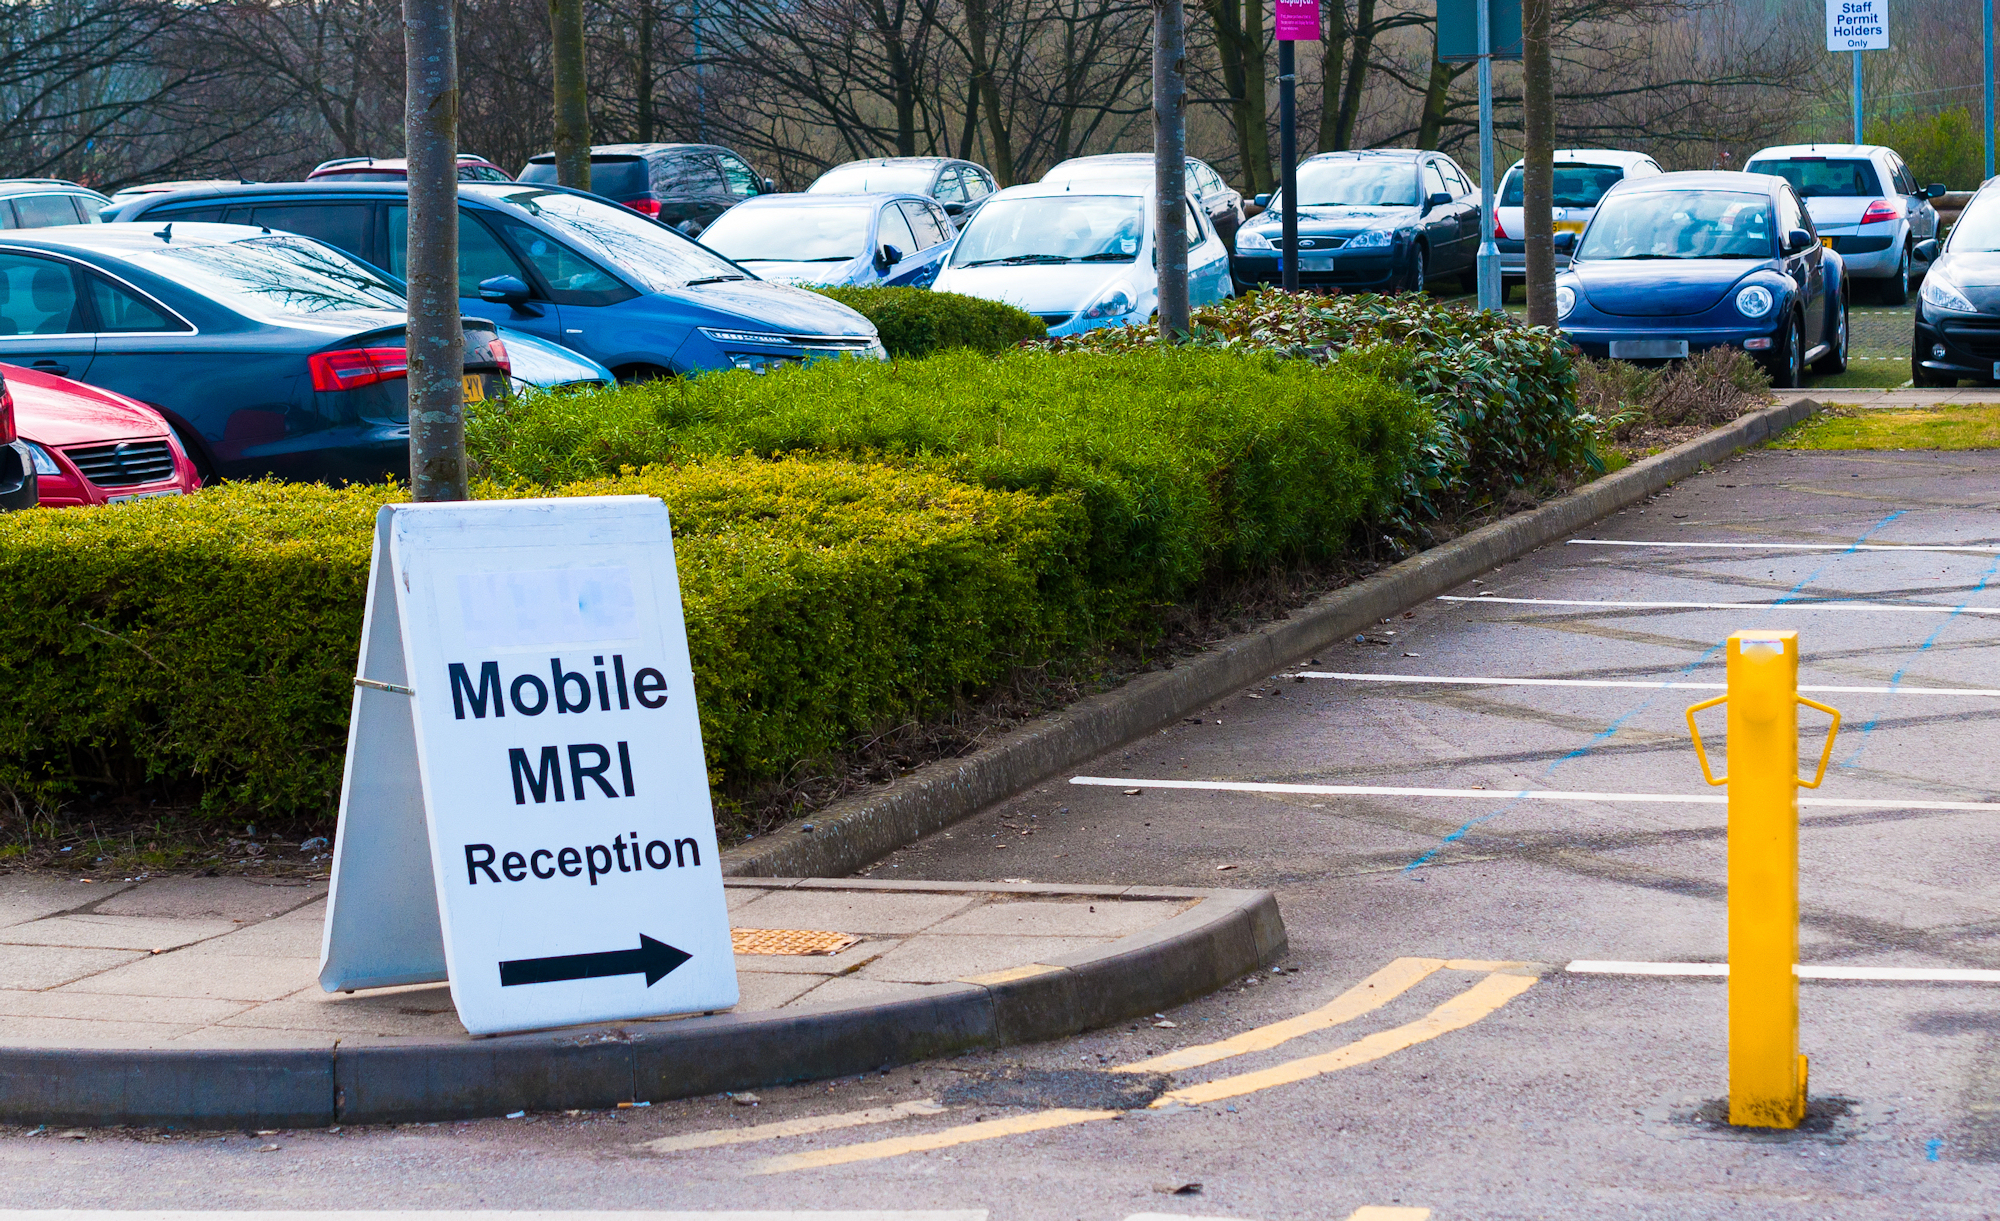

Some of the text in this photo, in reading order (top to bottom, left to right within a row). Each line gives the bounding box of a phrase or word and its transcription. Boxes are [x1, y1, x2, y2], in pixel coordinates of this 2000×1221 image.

[1842, 1, 1872, 13] Staff
[1837, 13, 1878, 25] Permit
[1833, 25, 1882, 37] Holders
[1847, 39, 1868, 48] Only
[448, 654, 668, 720] Mobile
[508, 741, 636, 805] MRI
[464, 831, 701, 886] Reception
